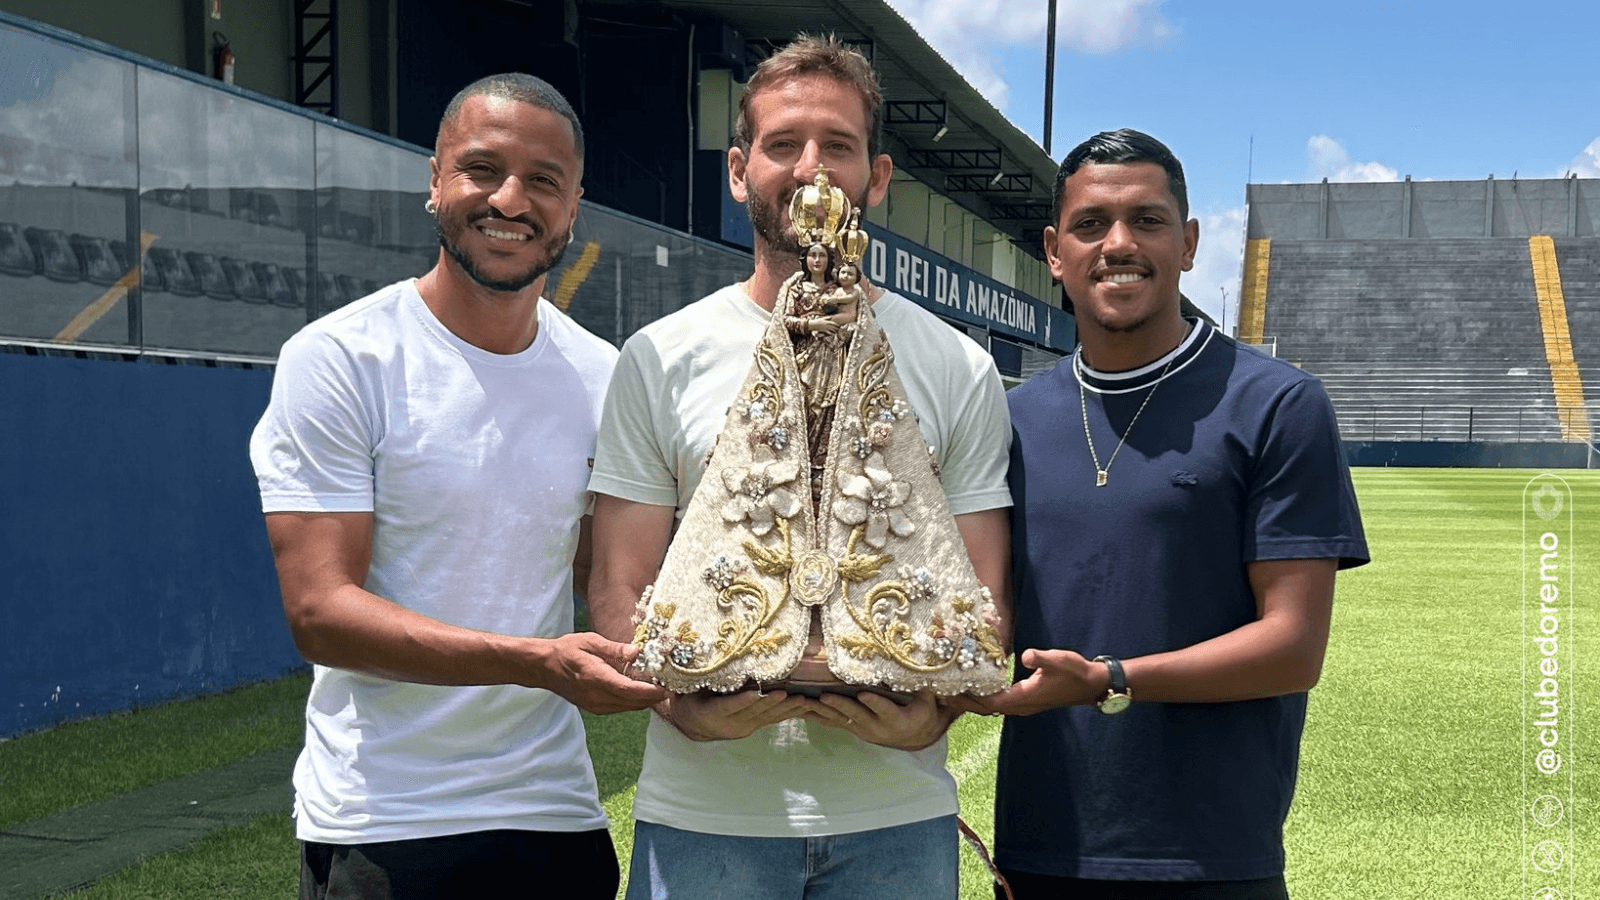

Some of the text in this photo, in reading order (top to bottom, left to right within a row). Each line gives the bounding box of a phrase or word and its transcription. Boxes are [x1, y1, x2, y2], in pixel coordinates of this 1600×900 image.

[870, 238, 1036, 335] O REI DA AMAZÔNIA
